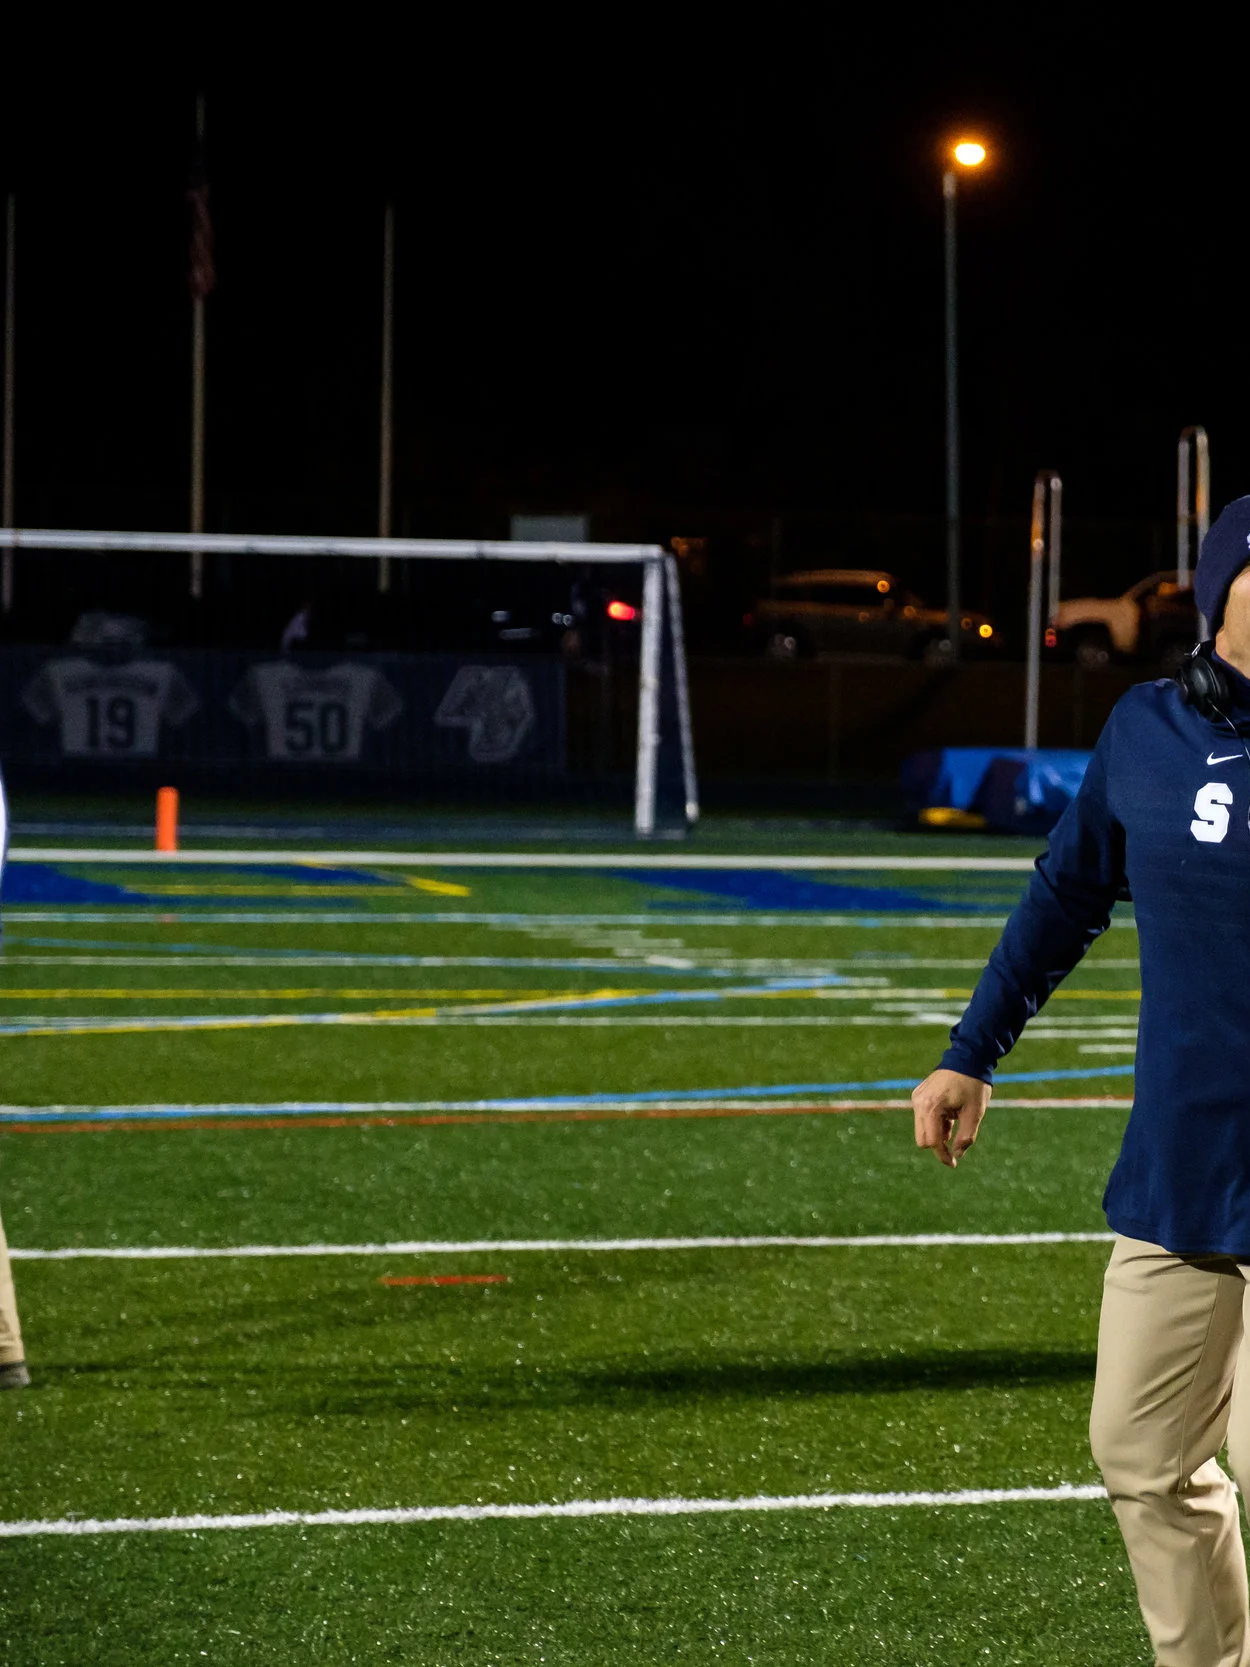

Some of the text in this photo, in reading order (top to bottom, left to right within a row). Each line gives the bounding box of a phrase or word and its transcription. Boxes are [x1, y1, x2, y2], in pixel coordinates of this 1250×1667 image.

[87, 697, 134, 748] 19
[285, 702, 347, 750] 50
[1190, 783, 1233, 843] S
